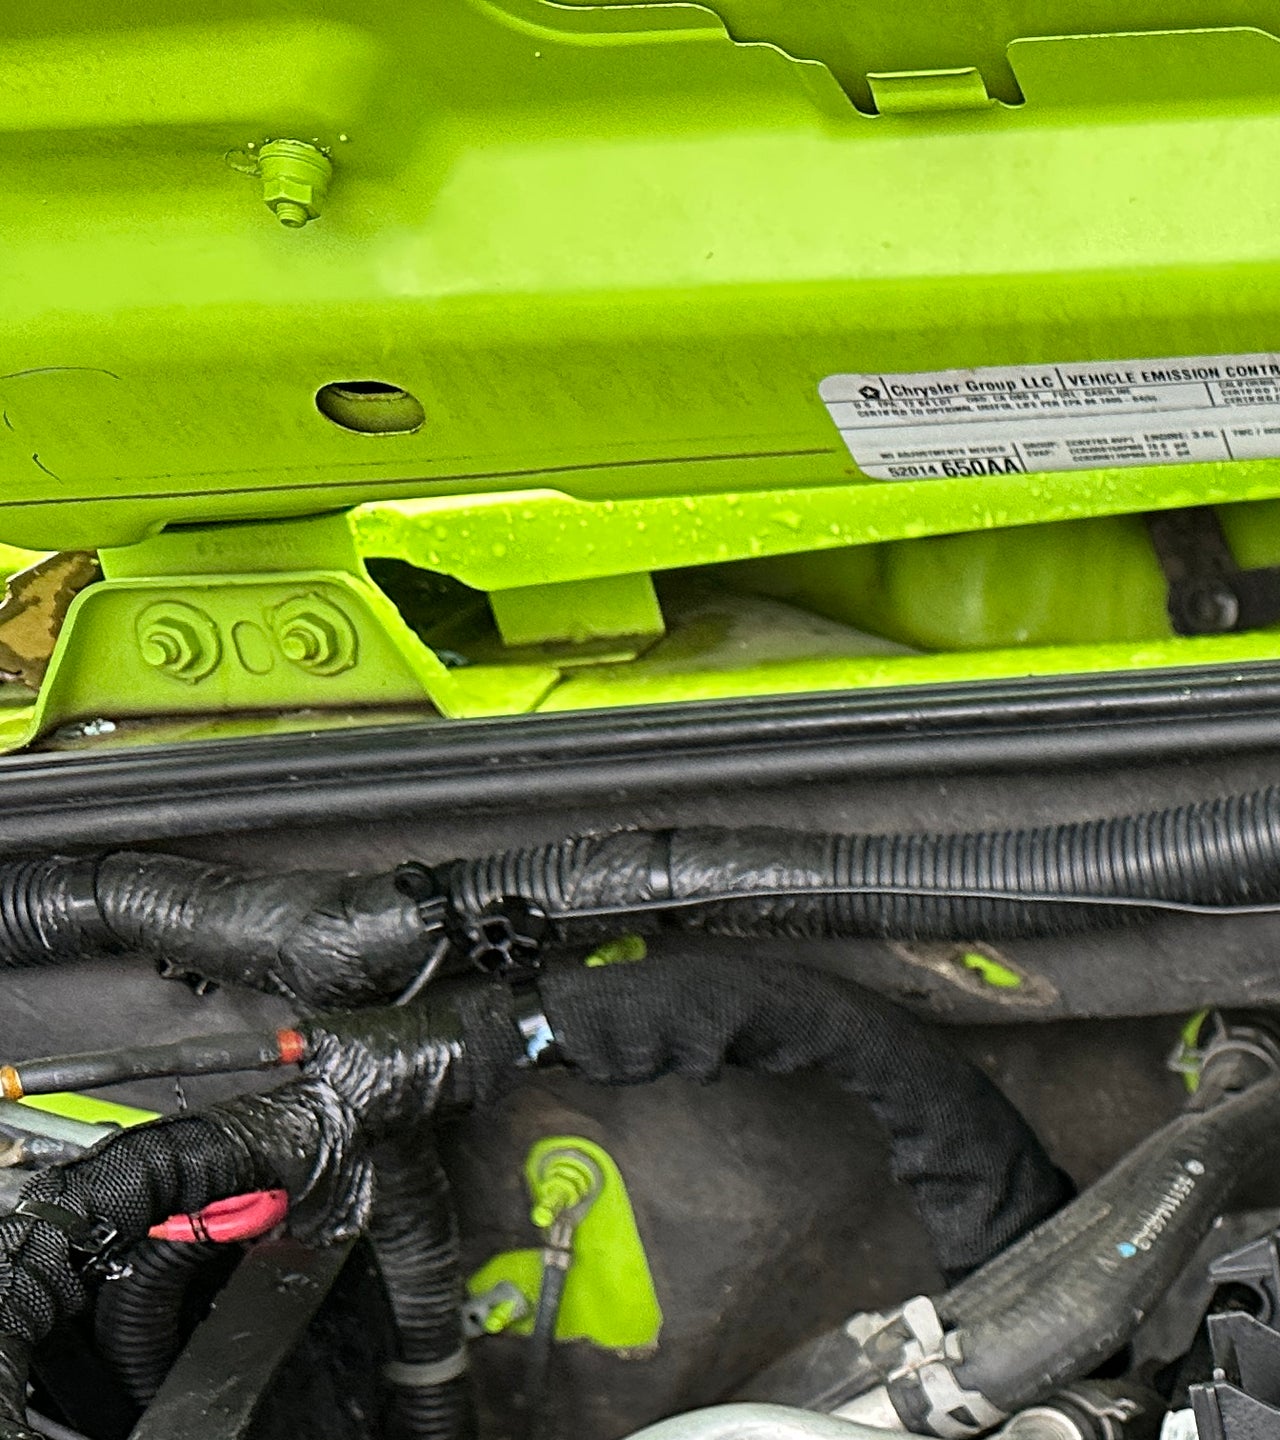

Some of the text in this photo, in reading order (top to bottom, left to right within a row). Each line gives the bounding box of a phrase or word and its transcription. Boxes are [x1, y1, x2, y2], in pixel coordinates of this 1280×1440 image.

[891, 375, 1054, 398] Chrysler Group LLC
[1066, 372, 1136, 386] VEHICLE
[1141, 367, 1220, 383] EMISSION
[888, 458, 1021, 478] 52014 650AA
